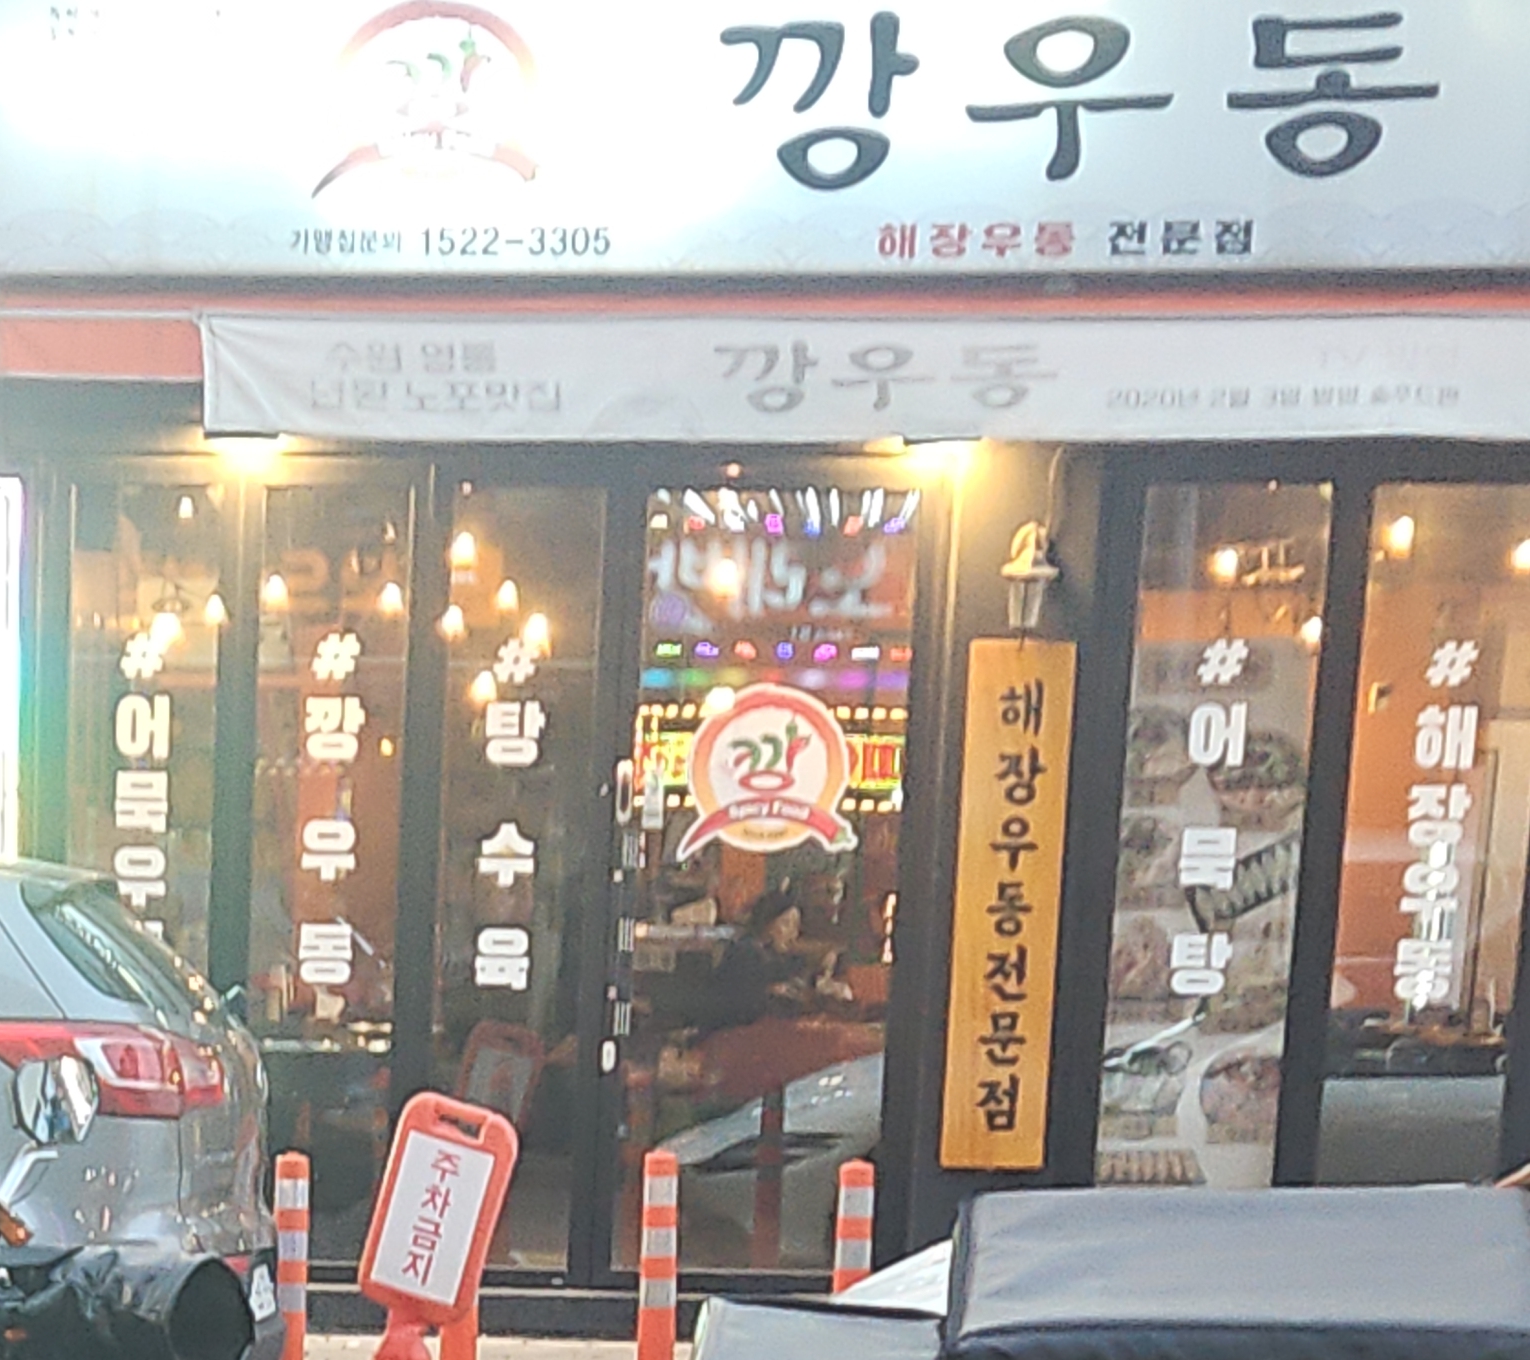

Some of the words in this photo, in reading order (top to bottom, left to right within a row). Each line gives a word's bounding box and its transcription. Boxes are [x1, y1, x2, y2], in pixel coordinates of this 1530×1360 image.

[720, 10, 1441, 191] 깡우동
[420, 226, 612, 257] 1522-3305
[876, 221, 1076, 259] 해장우동
[1107, 218, 1256, 257] 전문점
[713, 337, 1059, 414] 깡우동
[977, 680, 1047, 1133] 해장우동전문점
[402, 1148, 462, 1287] 주차금지
